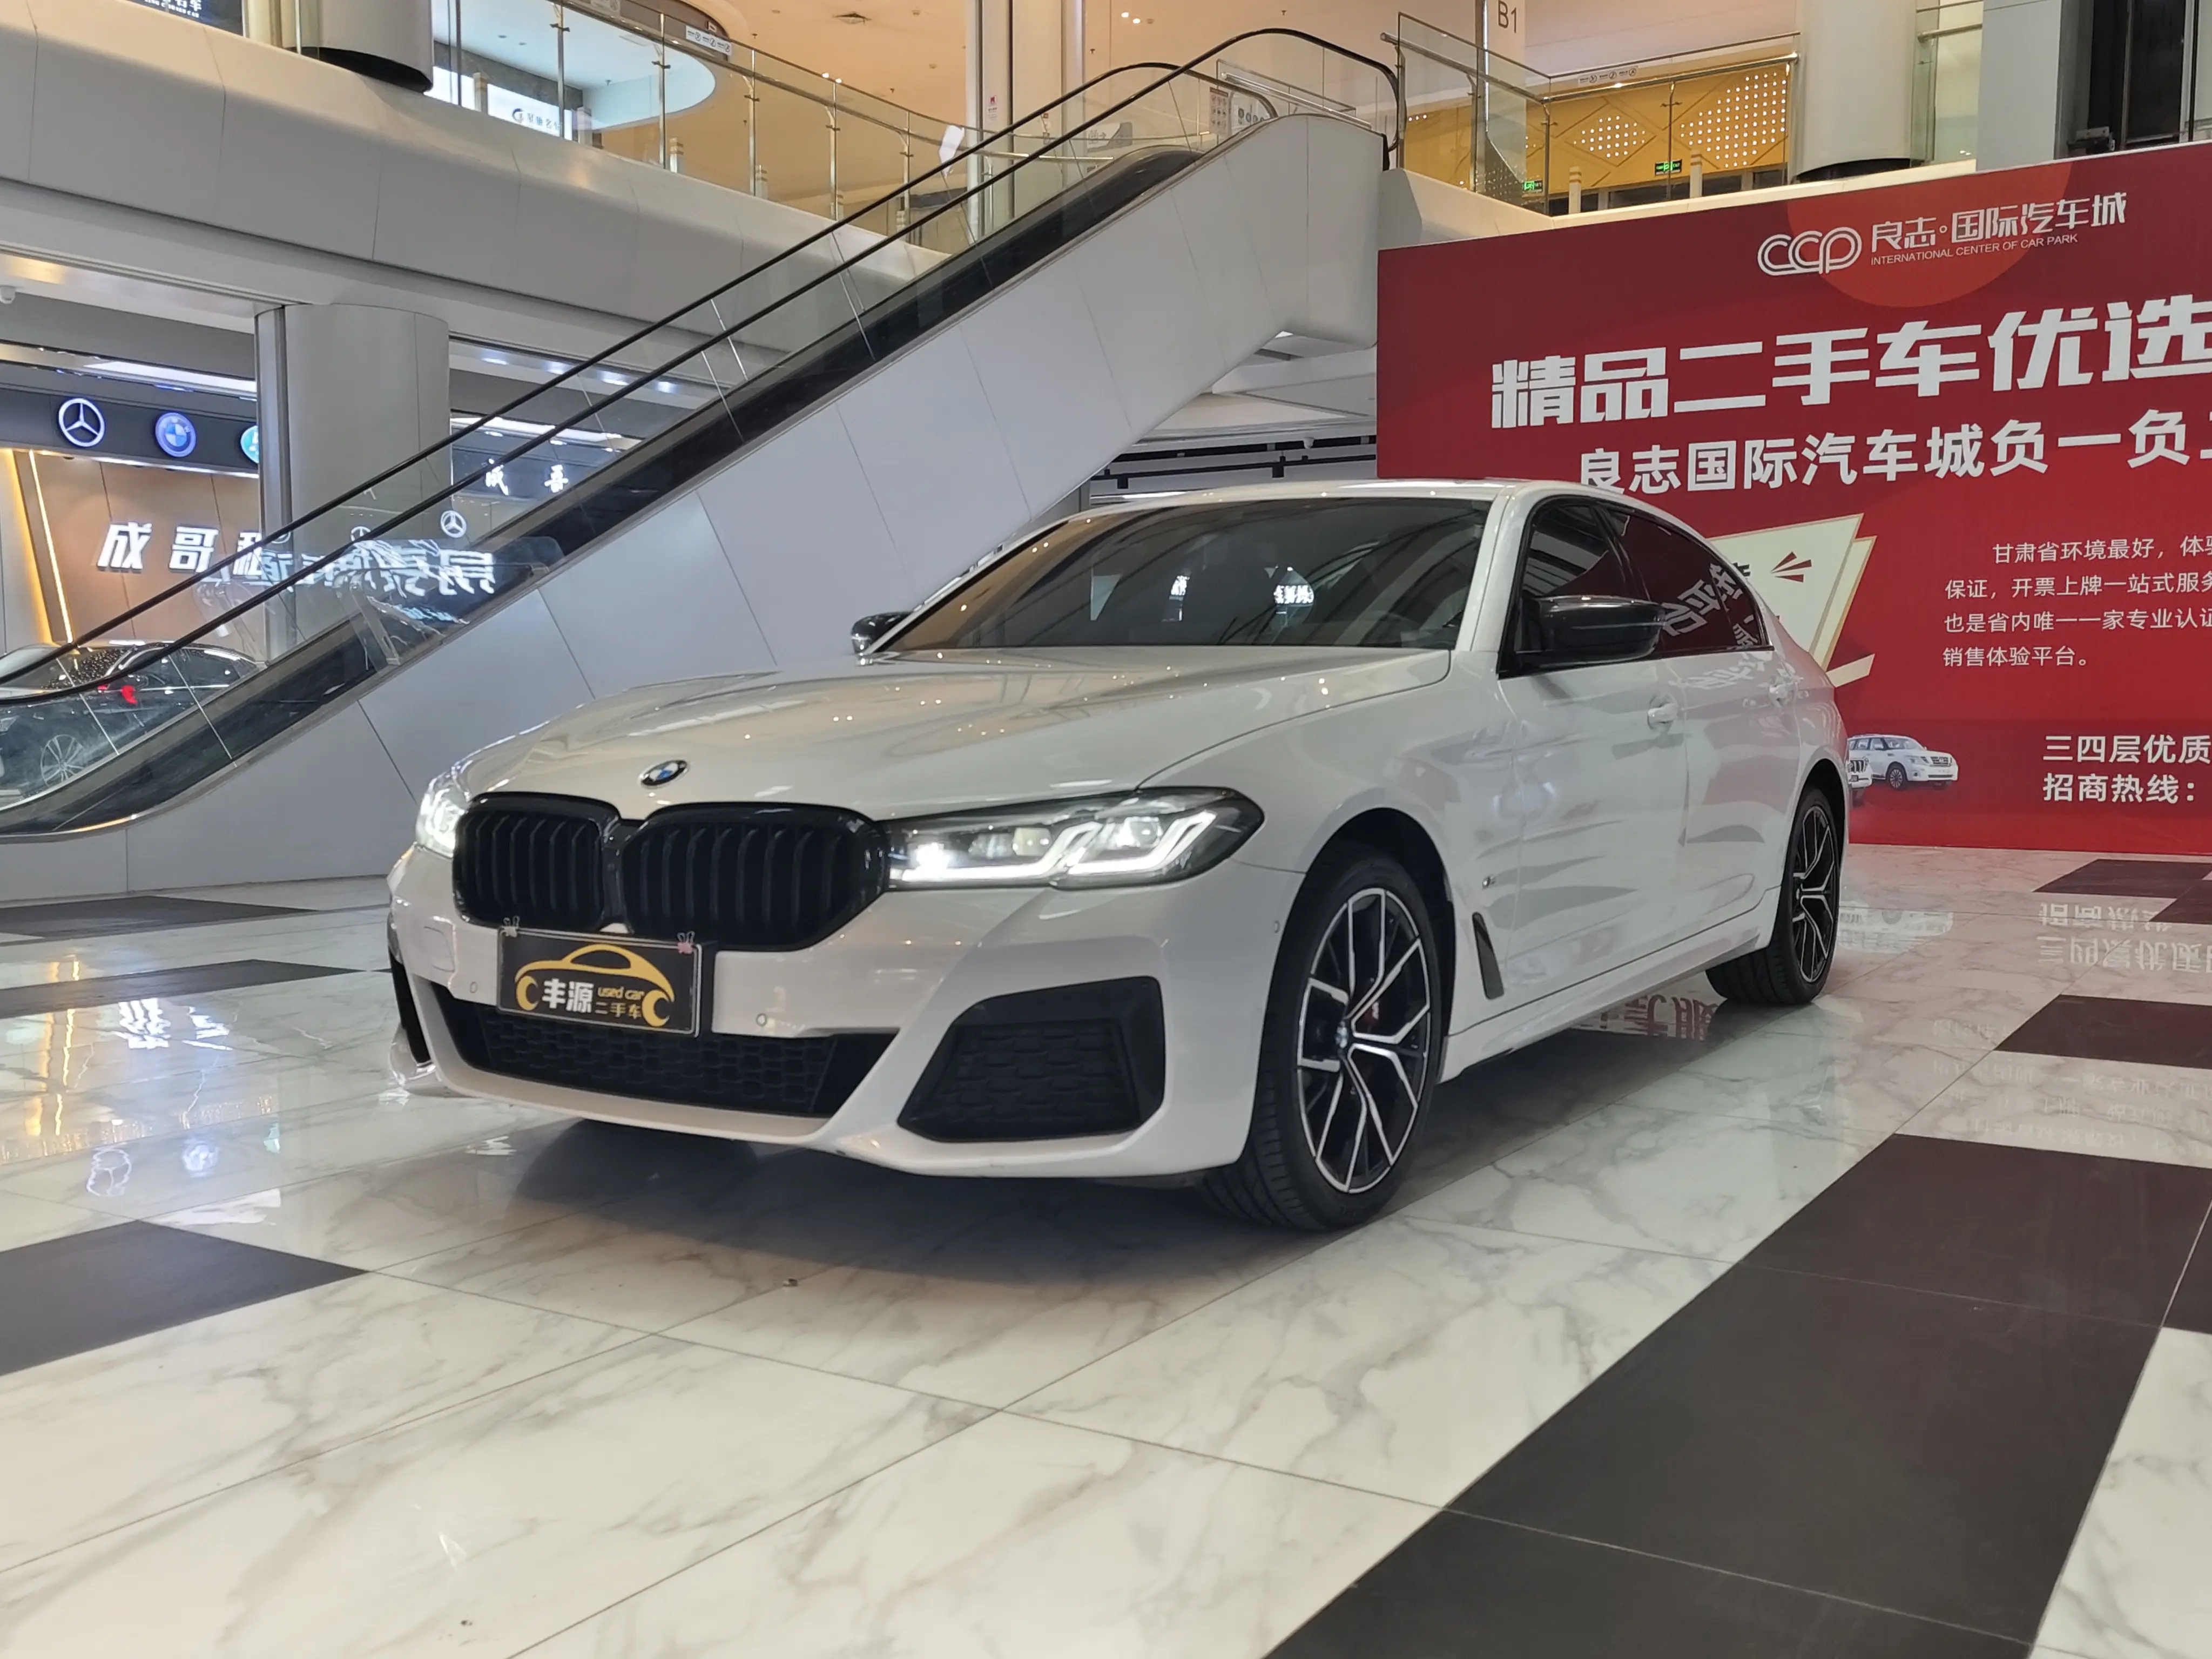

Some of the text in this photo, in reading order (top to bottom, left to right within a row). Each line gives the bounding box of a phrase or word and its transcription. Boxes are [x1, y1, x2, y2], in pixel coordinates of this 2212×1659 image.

[1498, 0, 1517, 33] B1
[1871, 233, 2078, 266] INTERNATIONAL CENTER OF CAR PARK
[1492, 294, 2212, 428] 精品二手车优选
[1943, 645, 2087, 666] 销售体验平台。
[2042, 734, 2212, 764] 三四层优质
[541, 977, 594, 1014] 丰源
[597, 986, 645, 1000] used car
[595, 1001, 642, 1020] 二手车
